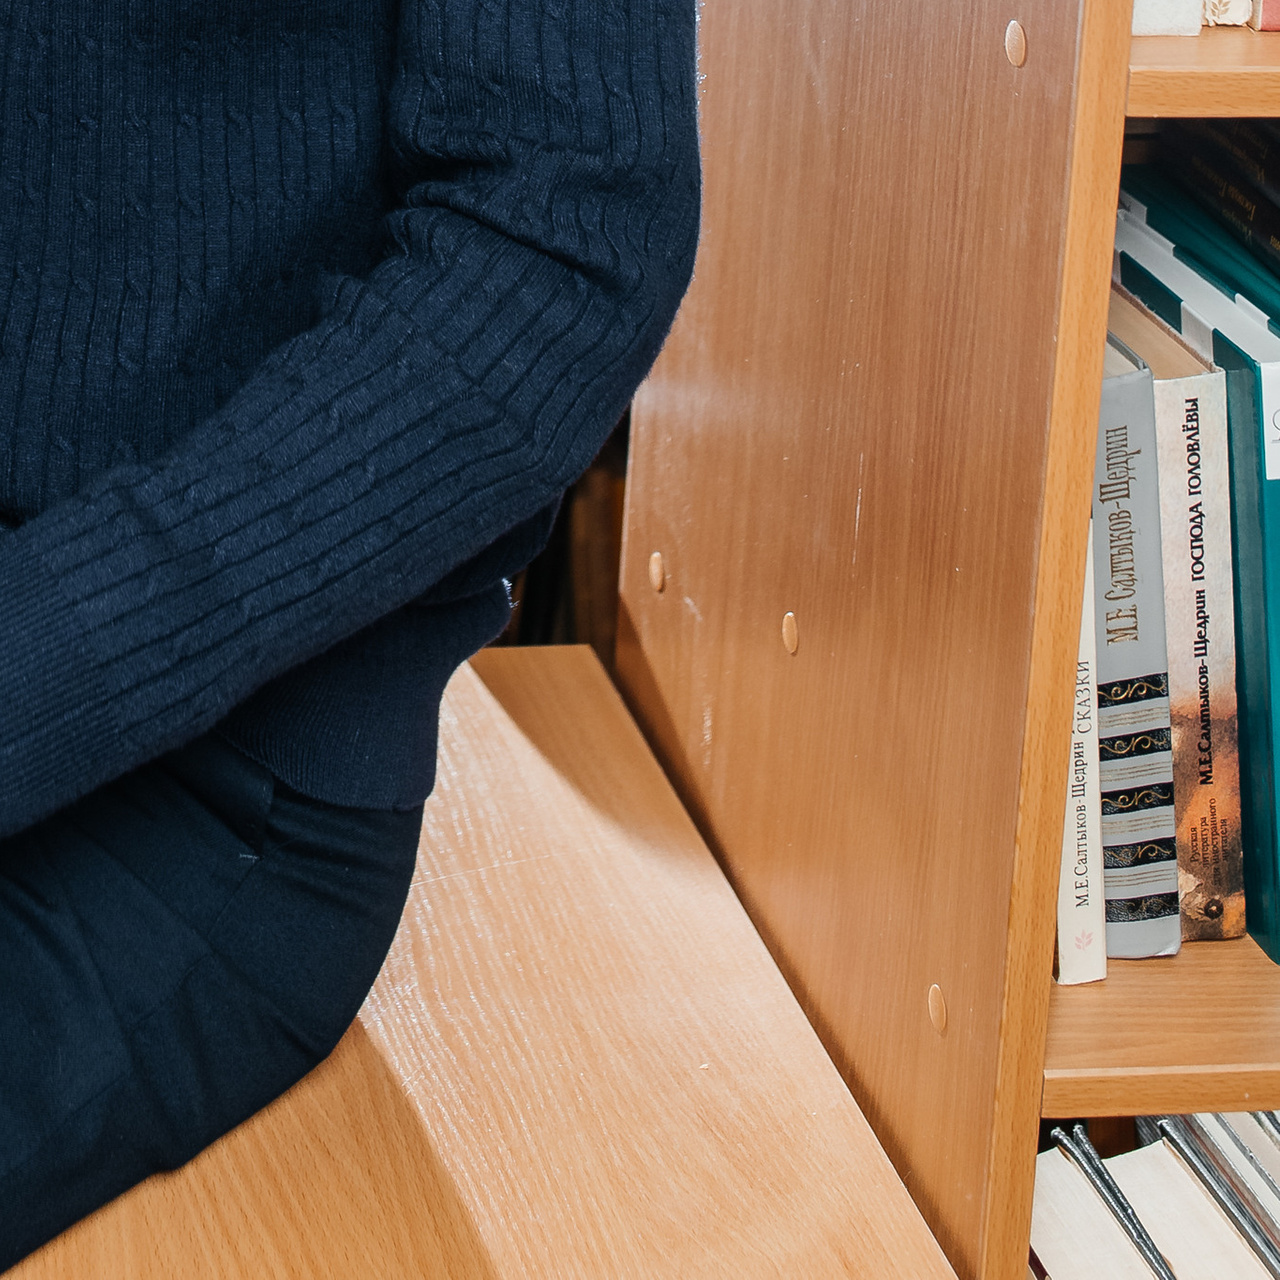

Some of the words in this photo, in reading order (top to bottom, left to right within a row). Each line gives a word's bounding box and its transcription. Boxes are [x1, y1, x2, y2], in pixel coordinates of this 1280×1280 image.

[1182, 397, 1202, 497] ГОЛОВЛЁВЫ
[1099, 425, 1142, 602] Салтыков-Щедрин
[1189, 501, 1206, 582] ГОСПОДА
[1076, 660, 1093, 735] СКАЗКИ
[1194, 589, 1214, 786] М.Е.Салтыков-Щедрин
[1190, 826, 1200, 863] Русская
[1209, 798, 1220, 864] иностранного
